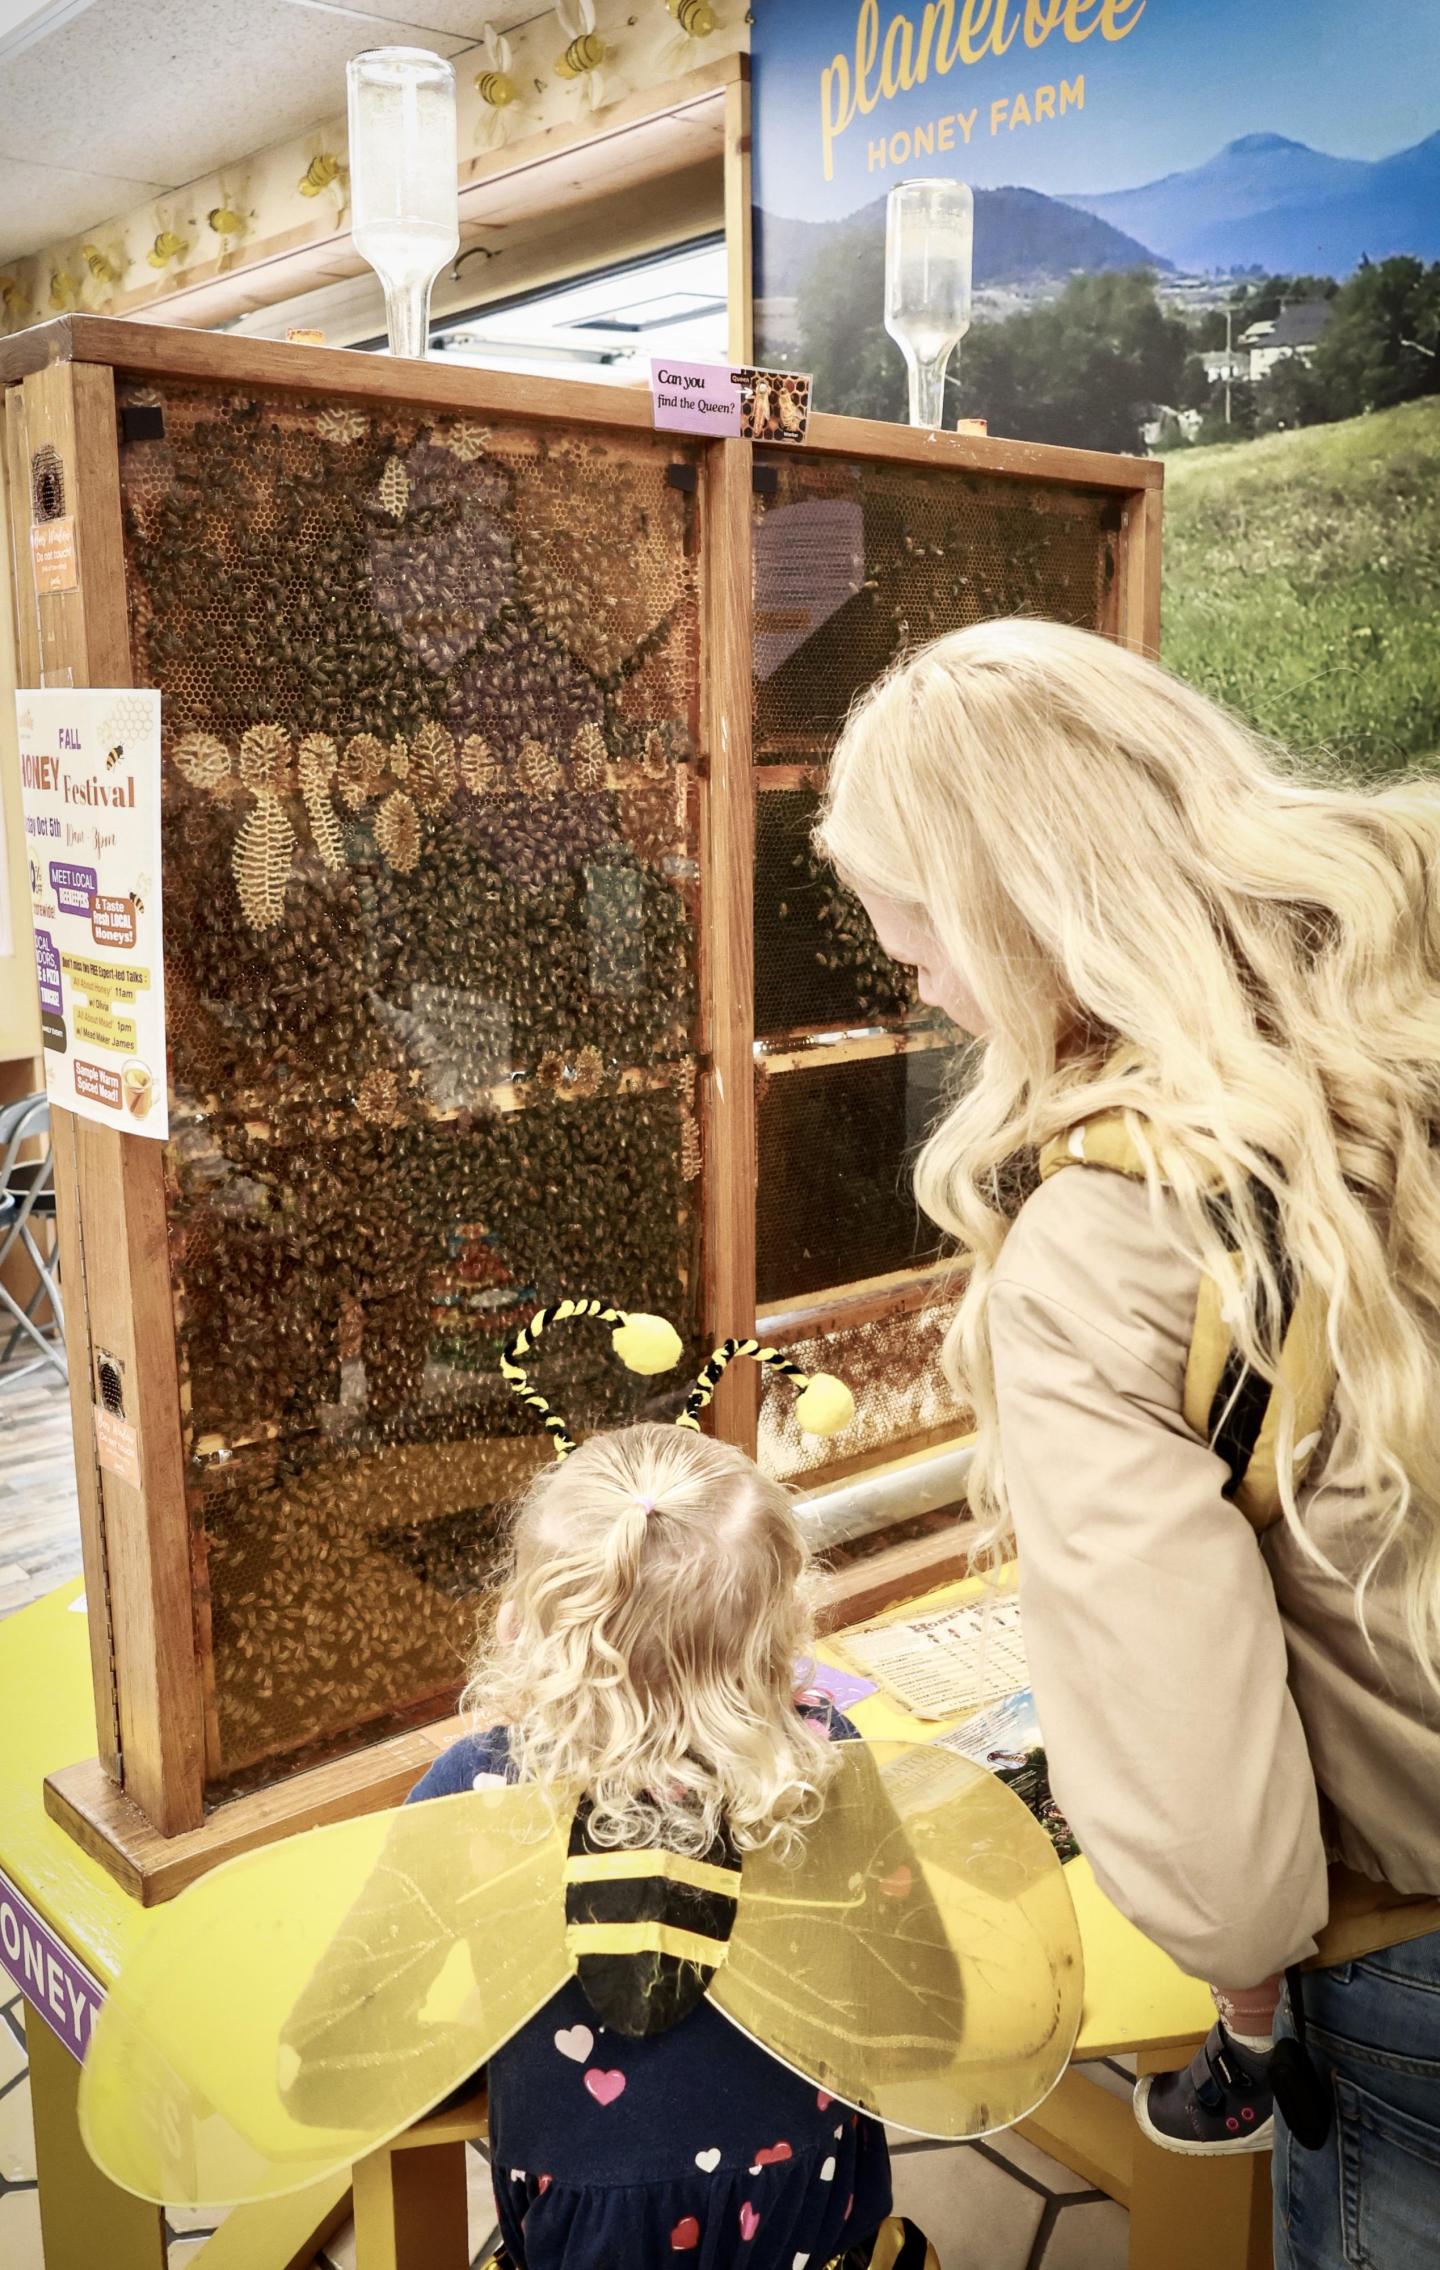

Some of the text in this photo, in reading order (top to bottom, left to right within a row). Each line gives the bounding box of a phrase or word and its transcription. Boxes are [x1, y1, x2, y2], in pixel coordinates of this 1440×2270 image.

[867, 74, 1085, 173] HONEY FARM
[658, 369, 705, 391] Can you
[731, 374, 750, 384] Queen
[657, 394, 735, 414] find the Queen?
[59, 728, 82, 750] FALL
[63, 775, 136, 808] Festival
[37, 816, 48, 836] Oct
[49, 817, 61, 837] 5th
[51, 868, 72, 885] MEET
[72, 872, 95, 890] LOCAL
[95, 898, 125, 913] & Taste
[111, 912, 133, 929] LOCAL
[95, 926, 133, 944] Honeys!
[126, 970, 143, 984] Talks
[115, 987, 133, 999] 11am
[117, 1021, 132, 1033] 1pm
[111, 1037, 135, 1050] James
[0, 1901, 87, 2042] ONEY
